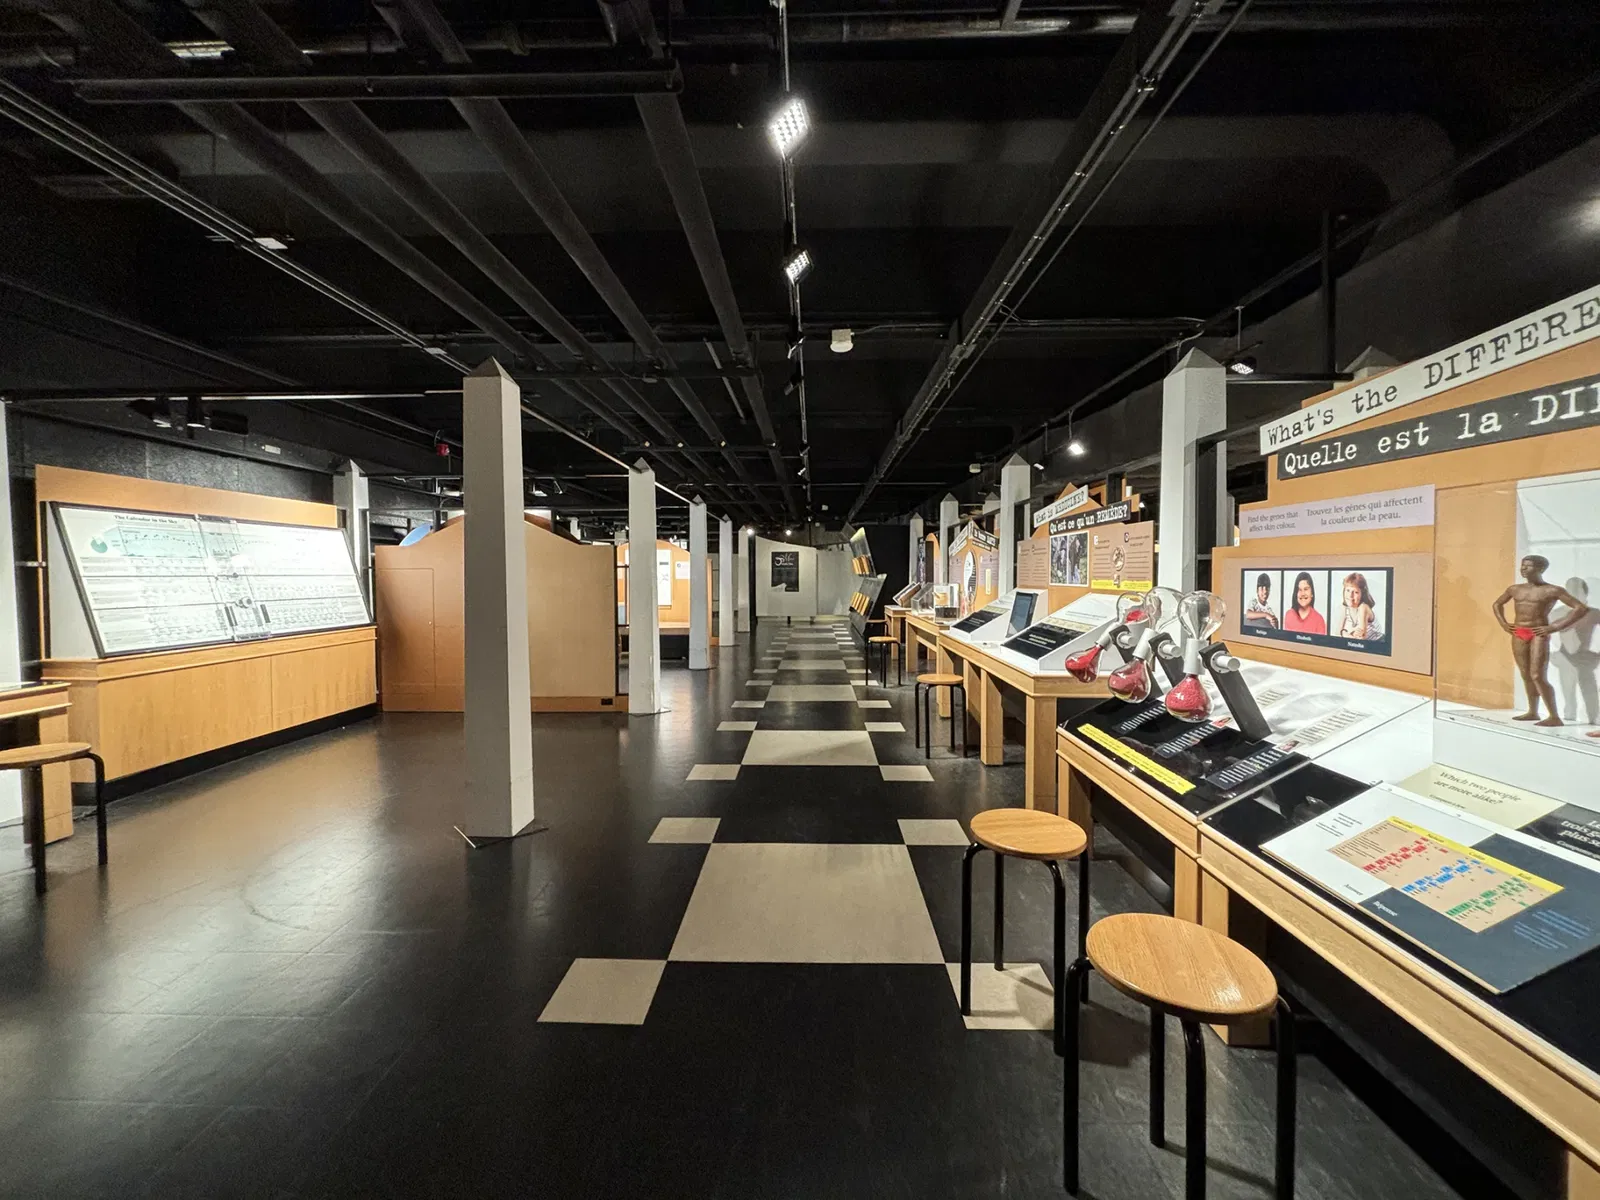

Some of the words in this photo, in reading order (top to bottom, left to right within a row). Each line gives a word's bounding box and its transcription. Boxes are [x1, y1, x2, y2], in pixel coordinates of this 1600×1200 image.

[1268, 409, 1334, 446] What's
[1352, 385, 1398, 414] the
[1424, 297, 1600, 389] DIFFERE
[1284, 442, 1357, 475] Quelle
[1377, 421, 1430, 453] est
[1457, 411, 1503, 439] la
[1307, 507, 1333, 517] Trouvez
[1334, 505, 1343, 514] les
[1344, 503, 1366, 515] gènes
[1367, 501, 1382, 512] qui
[1383, 495, 1423, 508] affectent
[1260, 514, 1269, 522] the
[1270, 513, 1285, 523] genes
[1286, 511, 1298, 519] that
[1320, 517, 1327, 526] la
[1328, 515, 1356, 526] couleur
[1357, 513, 1367, 522] de
[1368, 512, 1376, 521] la
[1378, 512, 1402, 523] peau.
[1264, 522, 1275, 531] skin
[1434, 780, 1449, 788] are
[1448, 785, 1473, 796] more
[1472, 793, 1503, 805] alike?
[1440, 771, 1468, 785] Which
[1468, 781, 1487, 791] two
[1485, 788, 1522, 802] people
[1557, 829, 1590, 842] plus
[1561, 820, 1590, 833] trois
